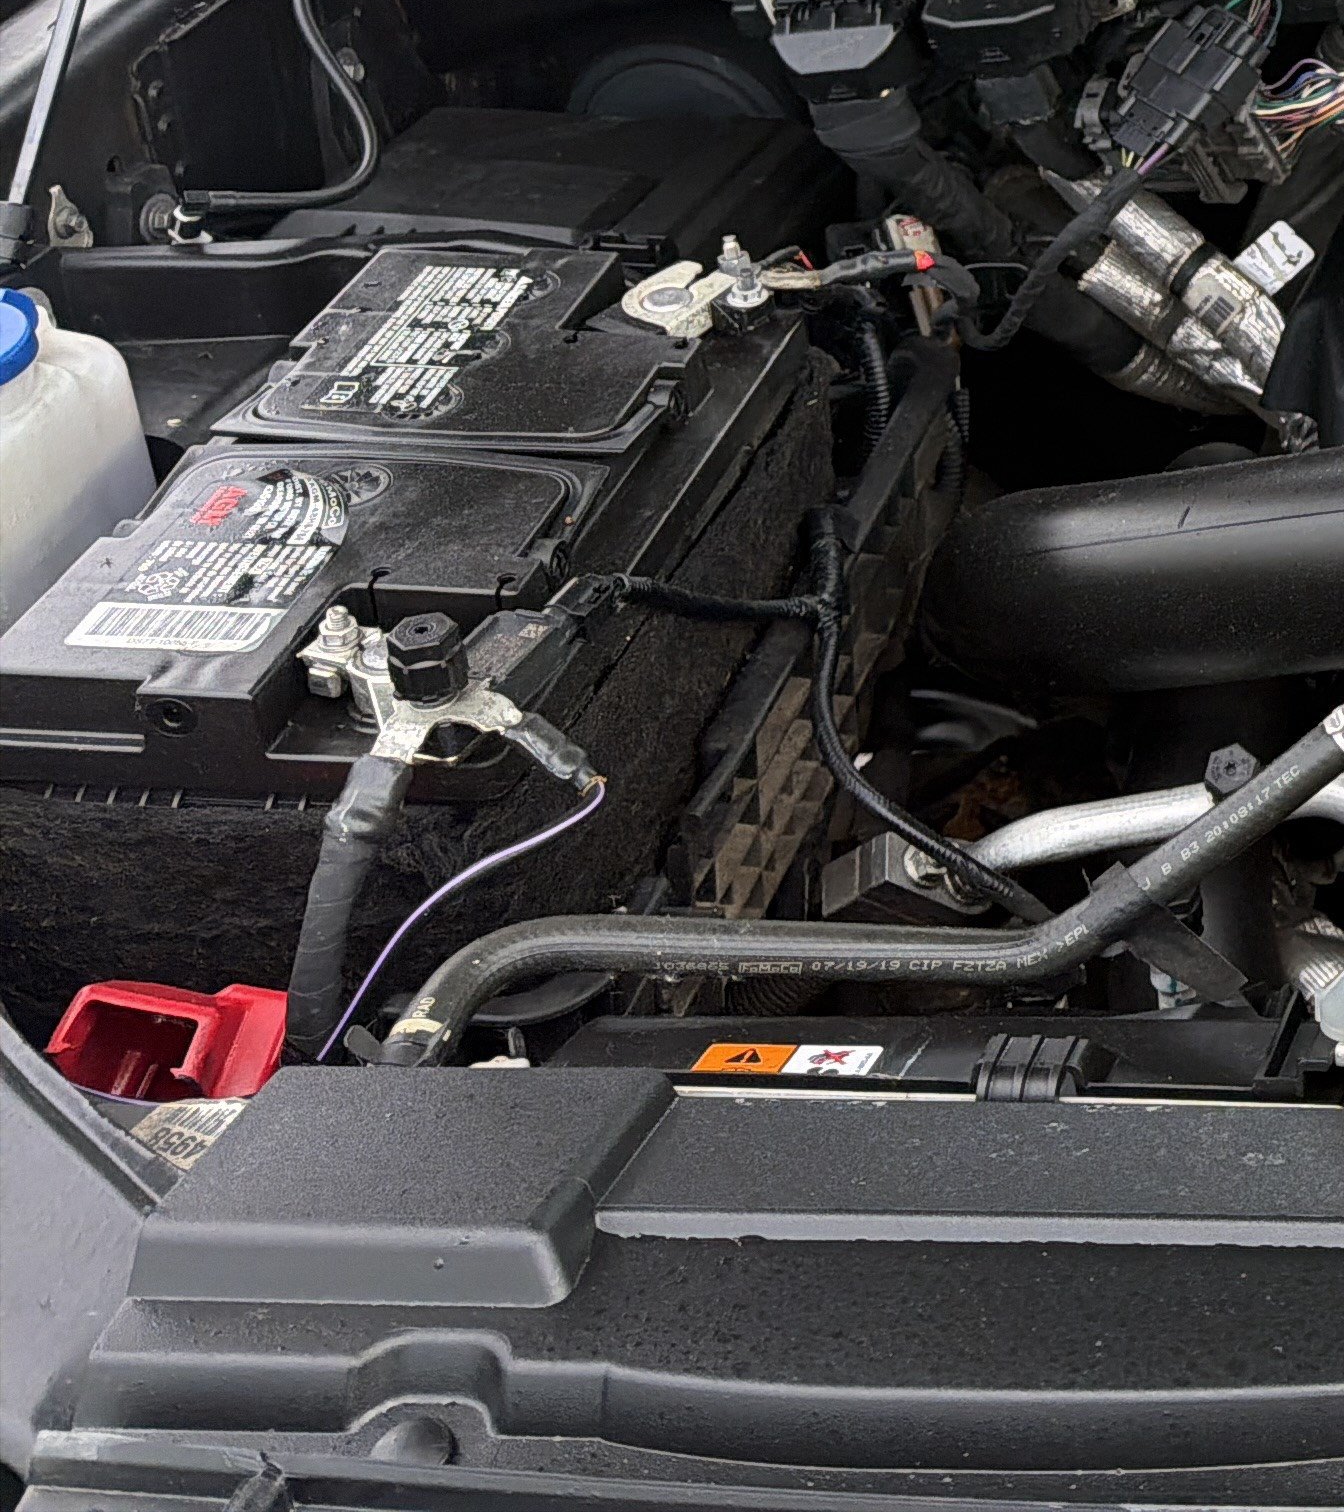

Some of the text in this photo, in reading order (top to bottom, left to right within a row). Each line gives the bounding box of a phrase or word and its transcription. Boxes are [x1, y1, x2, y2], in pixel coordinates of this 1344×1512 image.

[325, 483, 342, 527] MoCo
[1272, 763, 1302, 790] TEC
[908, 959, 943, 971] CIP
[1015, 949, 1048, 969] MEX
[411, 995, 437, 1019] RAD
